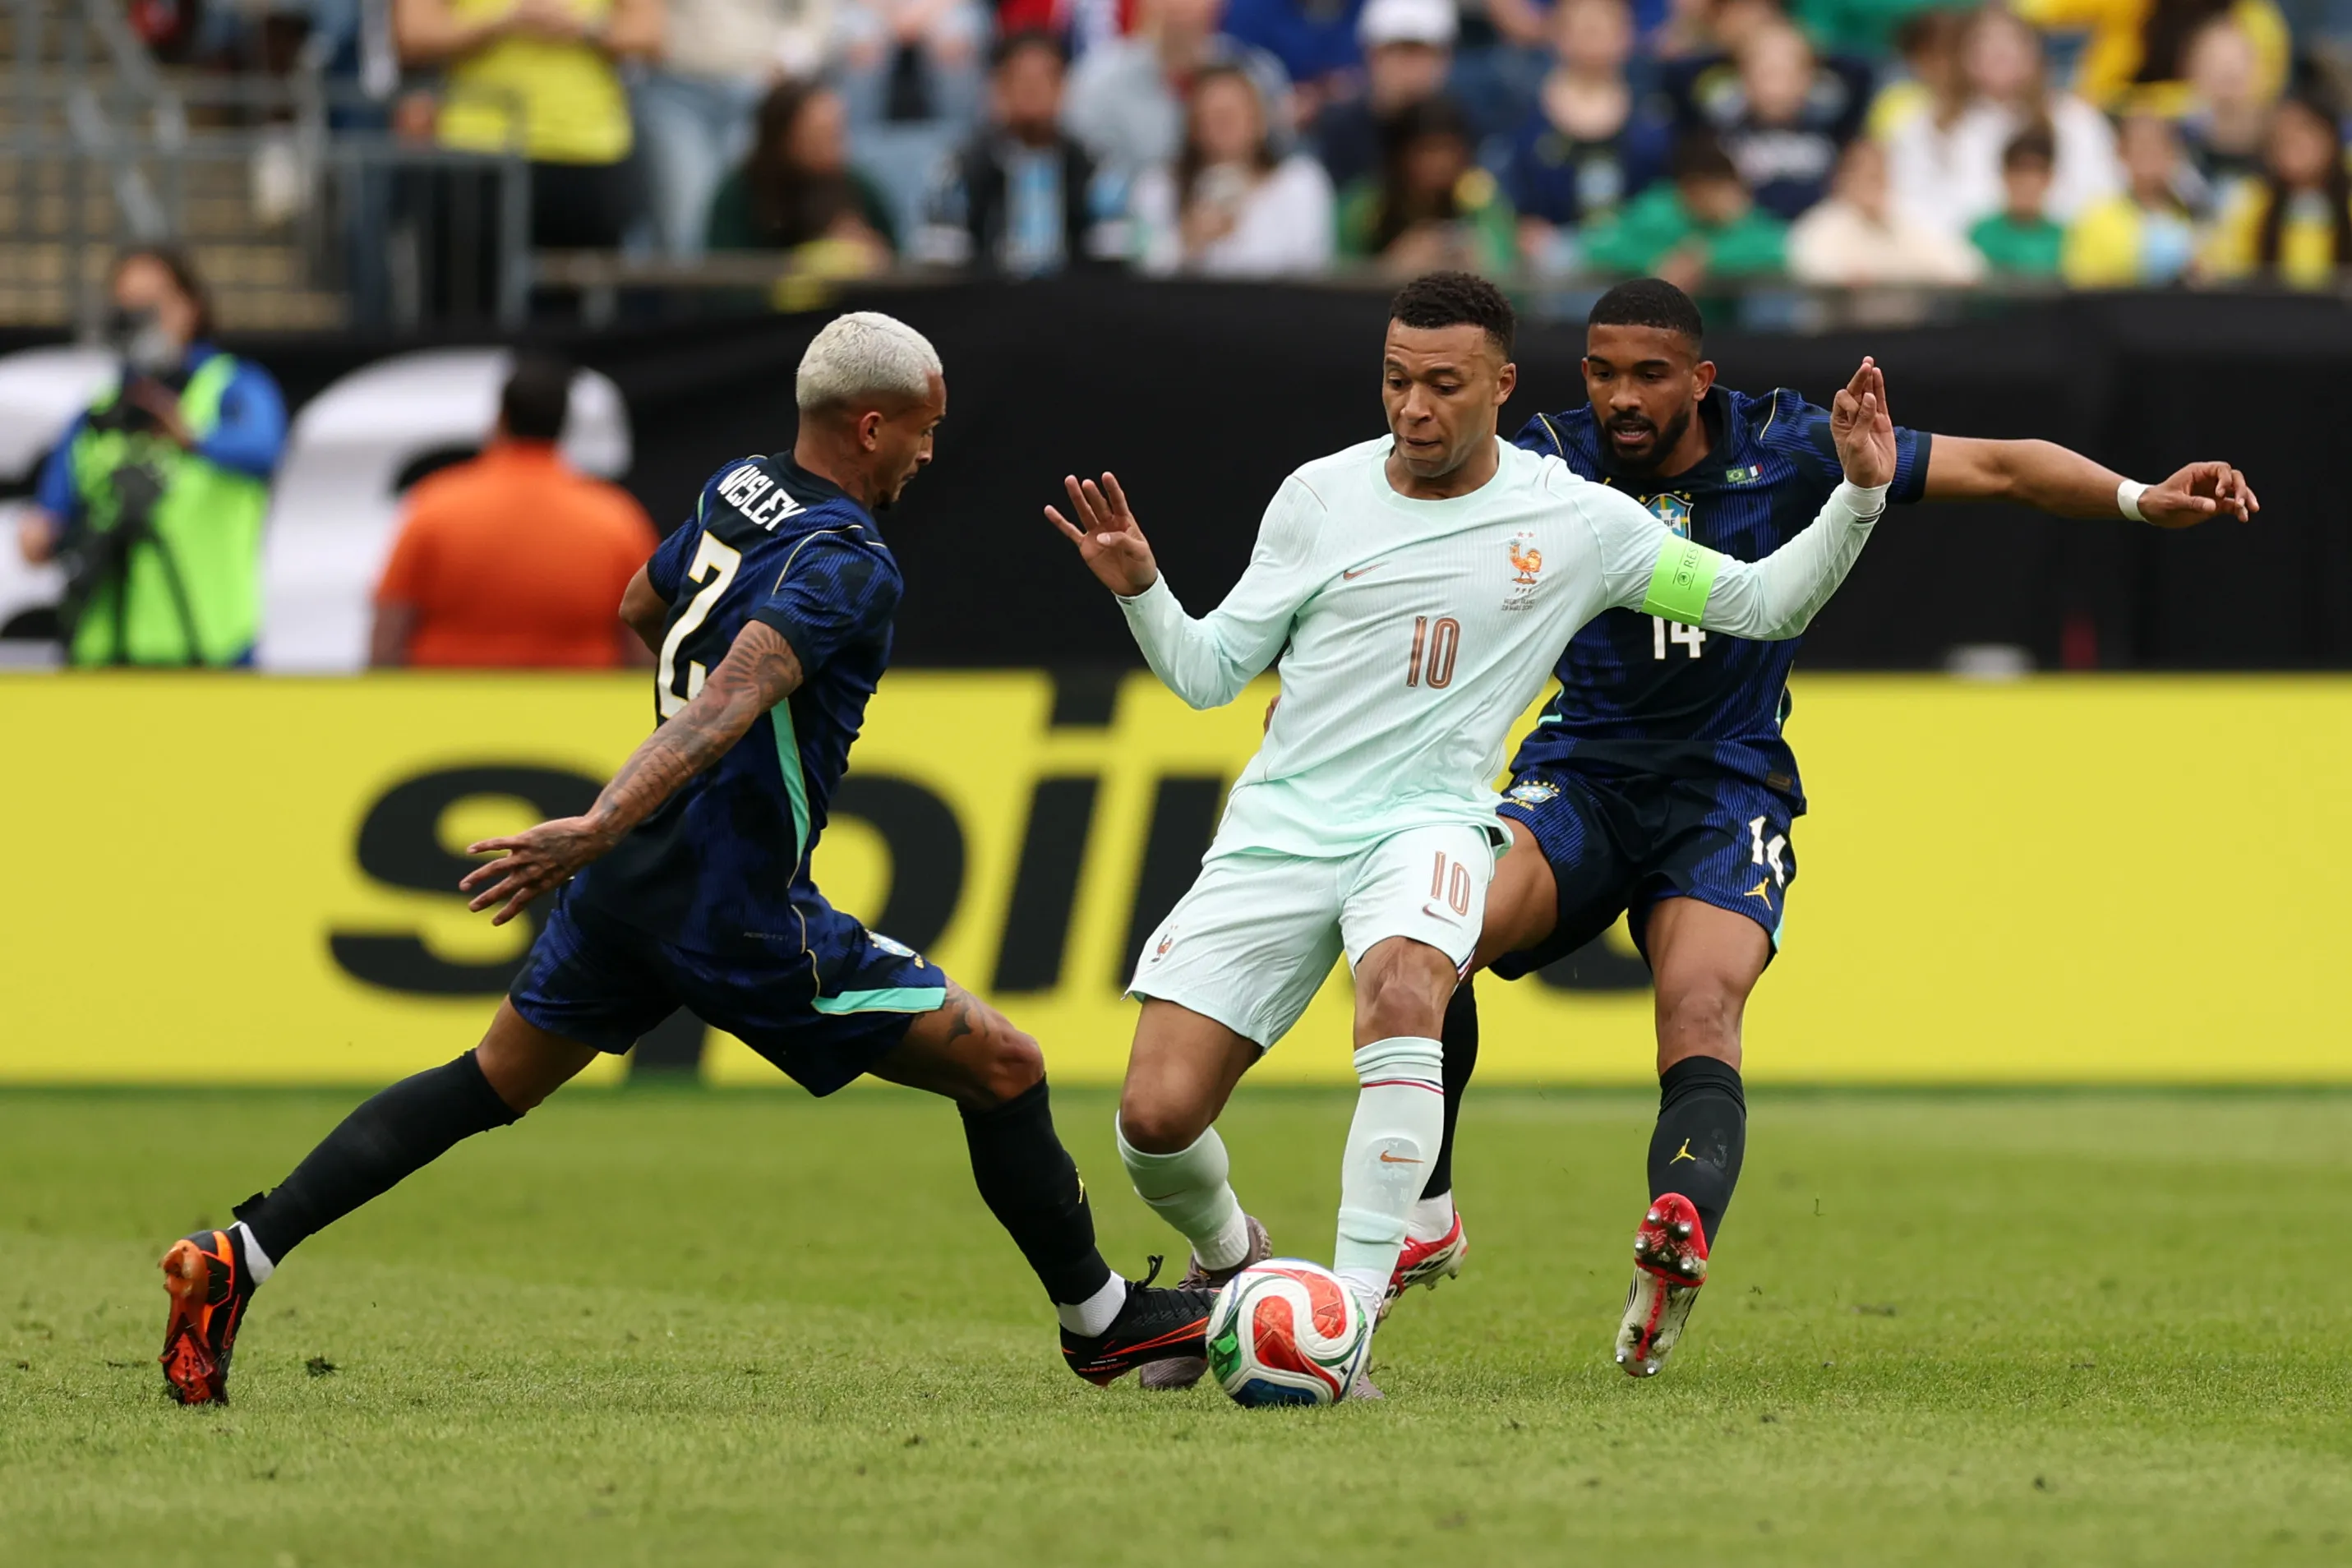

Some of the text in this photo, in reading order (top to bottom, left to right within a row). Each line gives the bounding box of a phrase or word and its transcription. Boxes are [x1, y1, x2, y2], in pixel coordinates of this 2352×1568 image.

[717, 463, 807, 532] WESLEY
[1683, 542, 1699, 569] RES
[658, 530, 741, 718] 2
[1406, 616, 1460, 689] 10
[1653, 616, 1707, 660] 14
[1430, 850, 1471, 917] 10
[1748, 814, 1787, 889] 14
